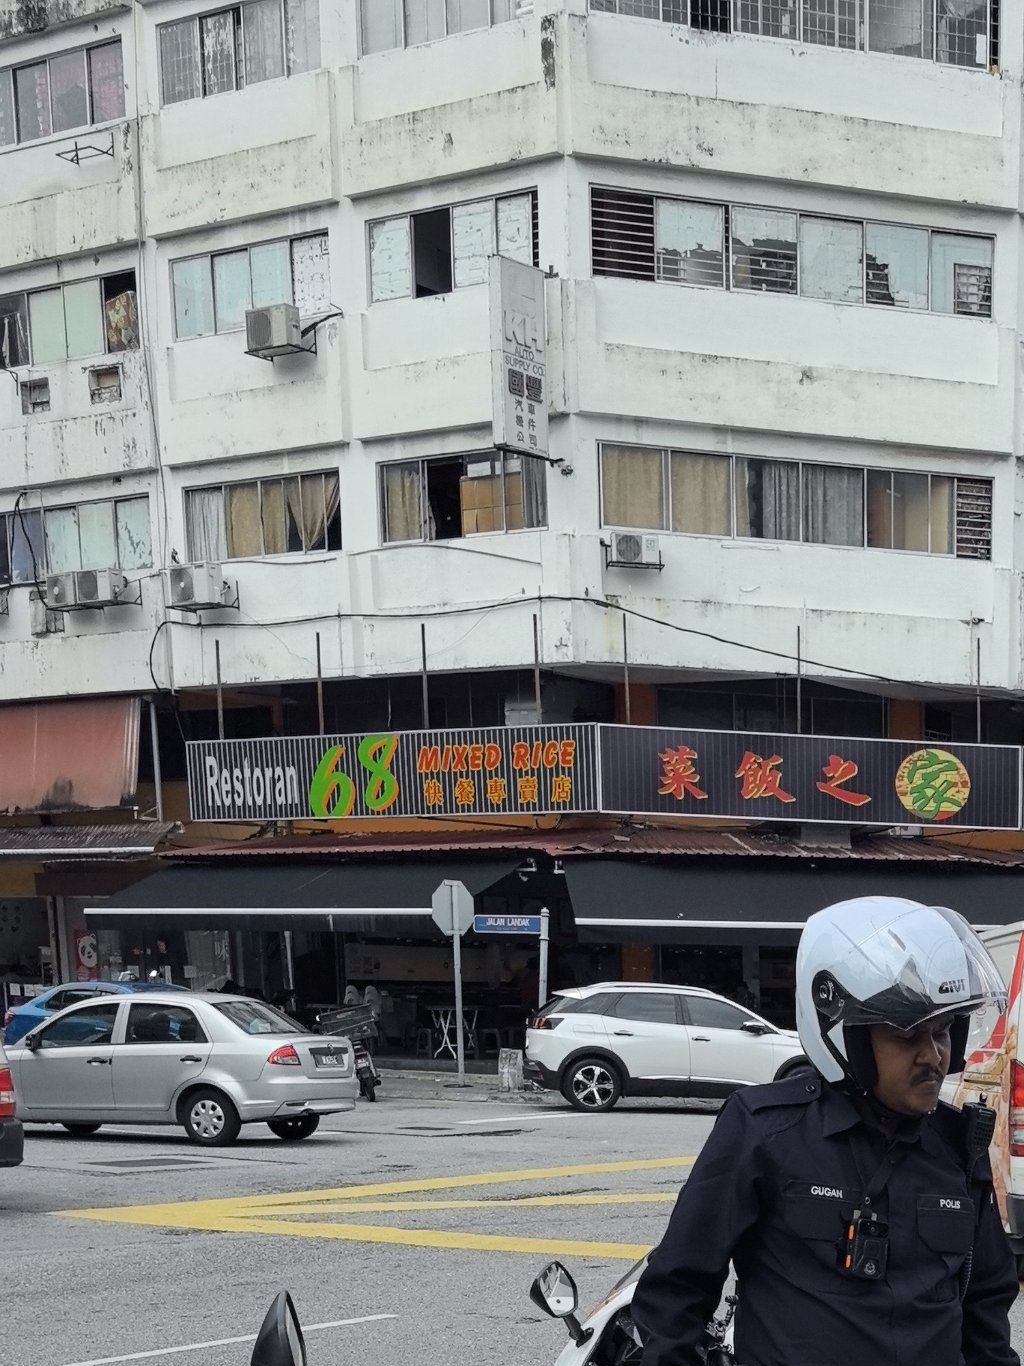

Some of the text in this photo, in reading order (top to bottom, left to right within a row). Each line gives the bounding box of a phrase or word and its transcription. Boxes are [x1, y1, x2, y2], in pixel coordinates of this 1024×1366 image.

[515, 346, 535, 361] AUTO
[505, 355, 531, 373] SUPPLY
[417, 739, 576, 773] MIXED RICE
[205, 734, 400, 818] Restoran 68
[423, 775, 572, 807] 快餐專賣店
[486, 917, 530, 927] JALAN LANDAK
[938, 978, 966, 994] GIVI
[810, 1185, 843, 1199] GUGAN
[940, 1199, 961, 1209] POLIS
